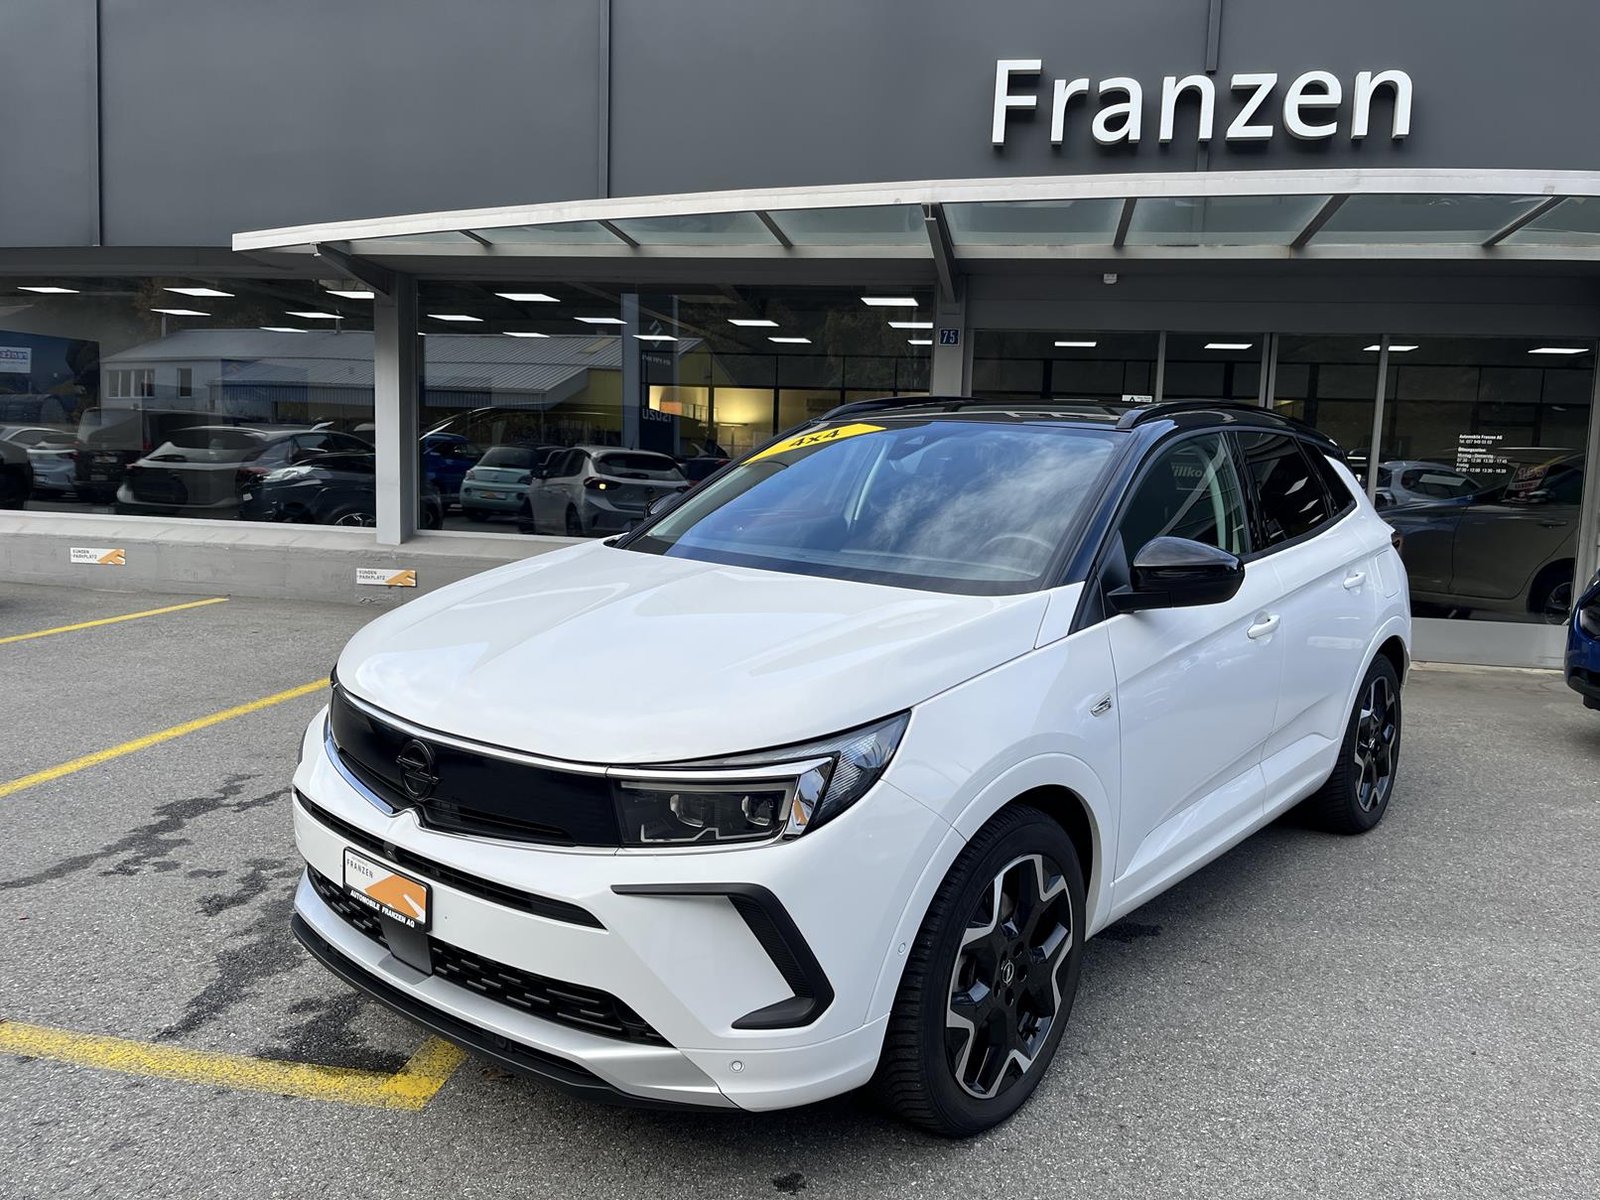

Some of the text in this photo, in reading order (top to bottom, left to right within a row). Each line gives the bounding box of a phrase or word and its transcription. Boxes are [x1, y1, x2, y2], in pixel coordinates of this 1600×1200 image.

[992, 59, 1413, 146] Franzen
[943, 331, 956, 343] 75
[789, 430, 839, 447] 4x4
[346, 859, 373, 878] FRANZEN
[350, 889, 415, 928] AUTOMOBILE FRANZEN AG
